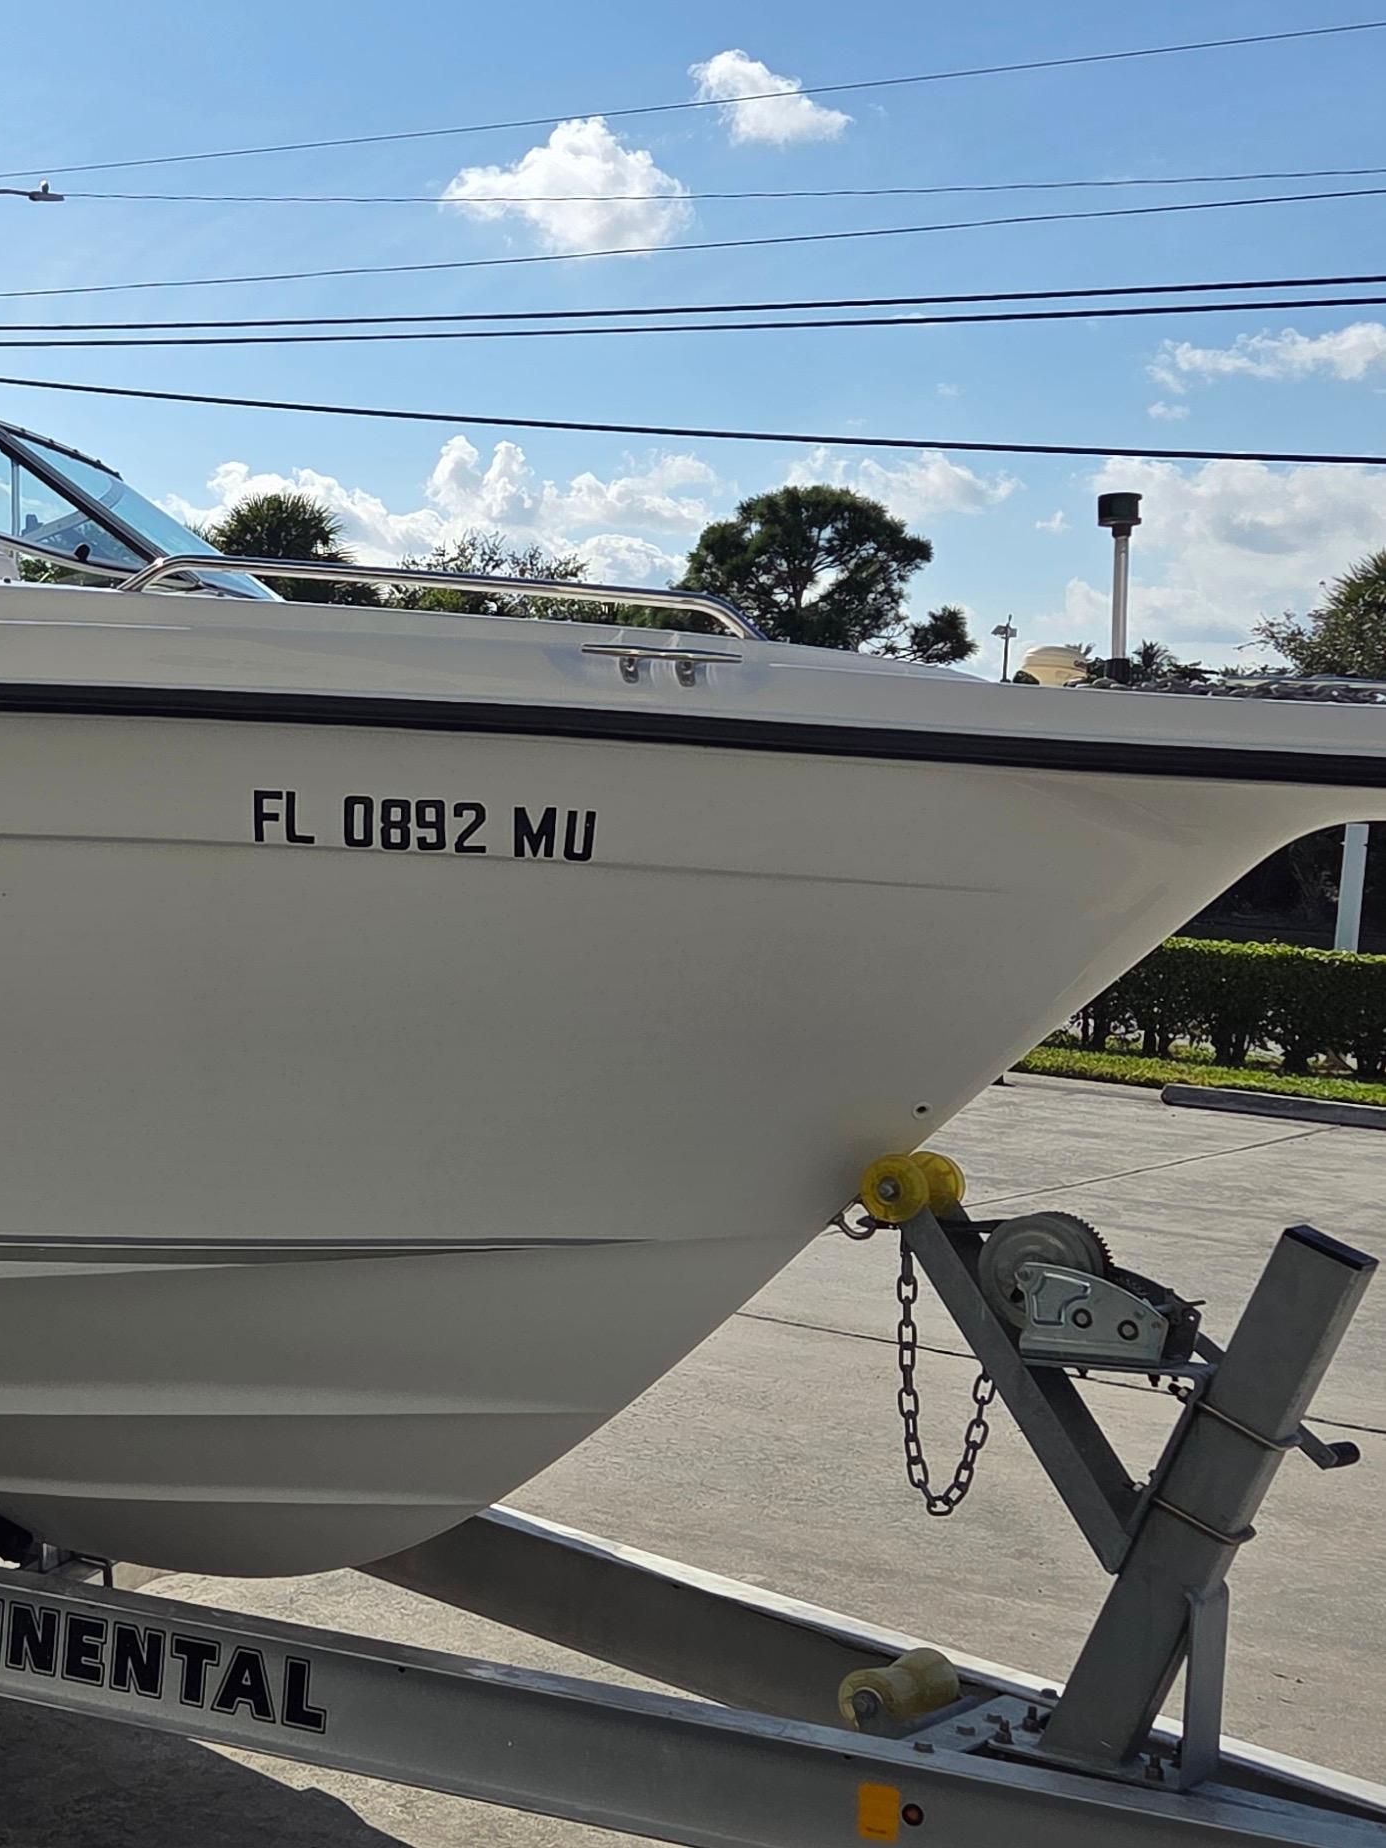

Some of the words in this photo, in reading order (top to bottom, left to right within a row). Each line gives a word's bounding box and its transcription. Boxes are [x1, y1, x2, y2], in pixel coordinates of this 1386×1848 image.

[253, 789, 315, 844] FL
[343, 795, 487, 854] 0892
[514, 805, 597, 861] MU
